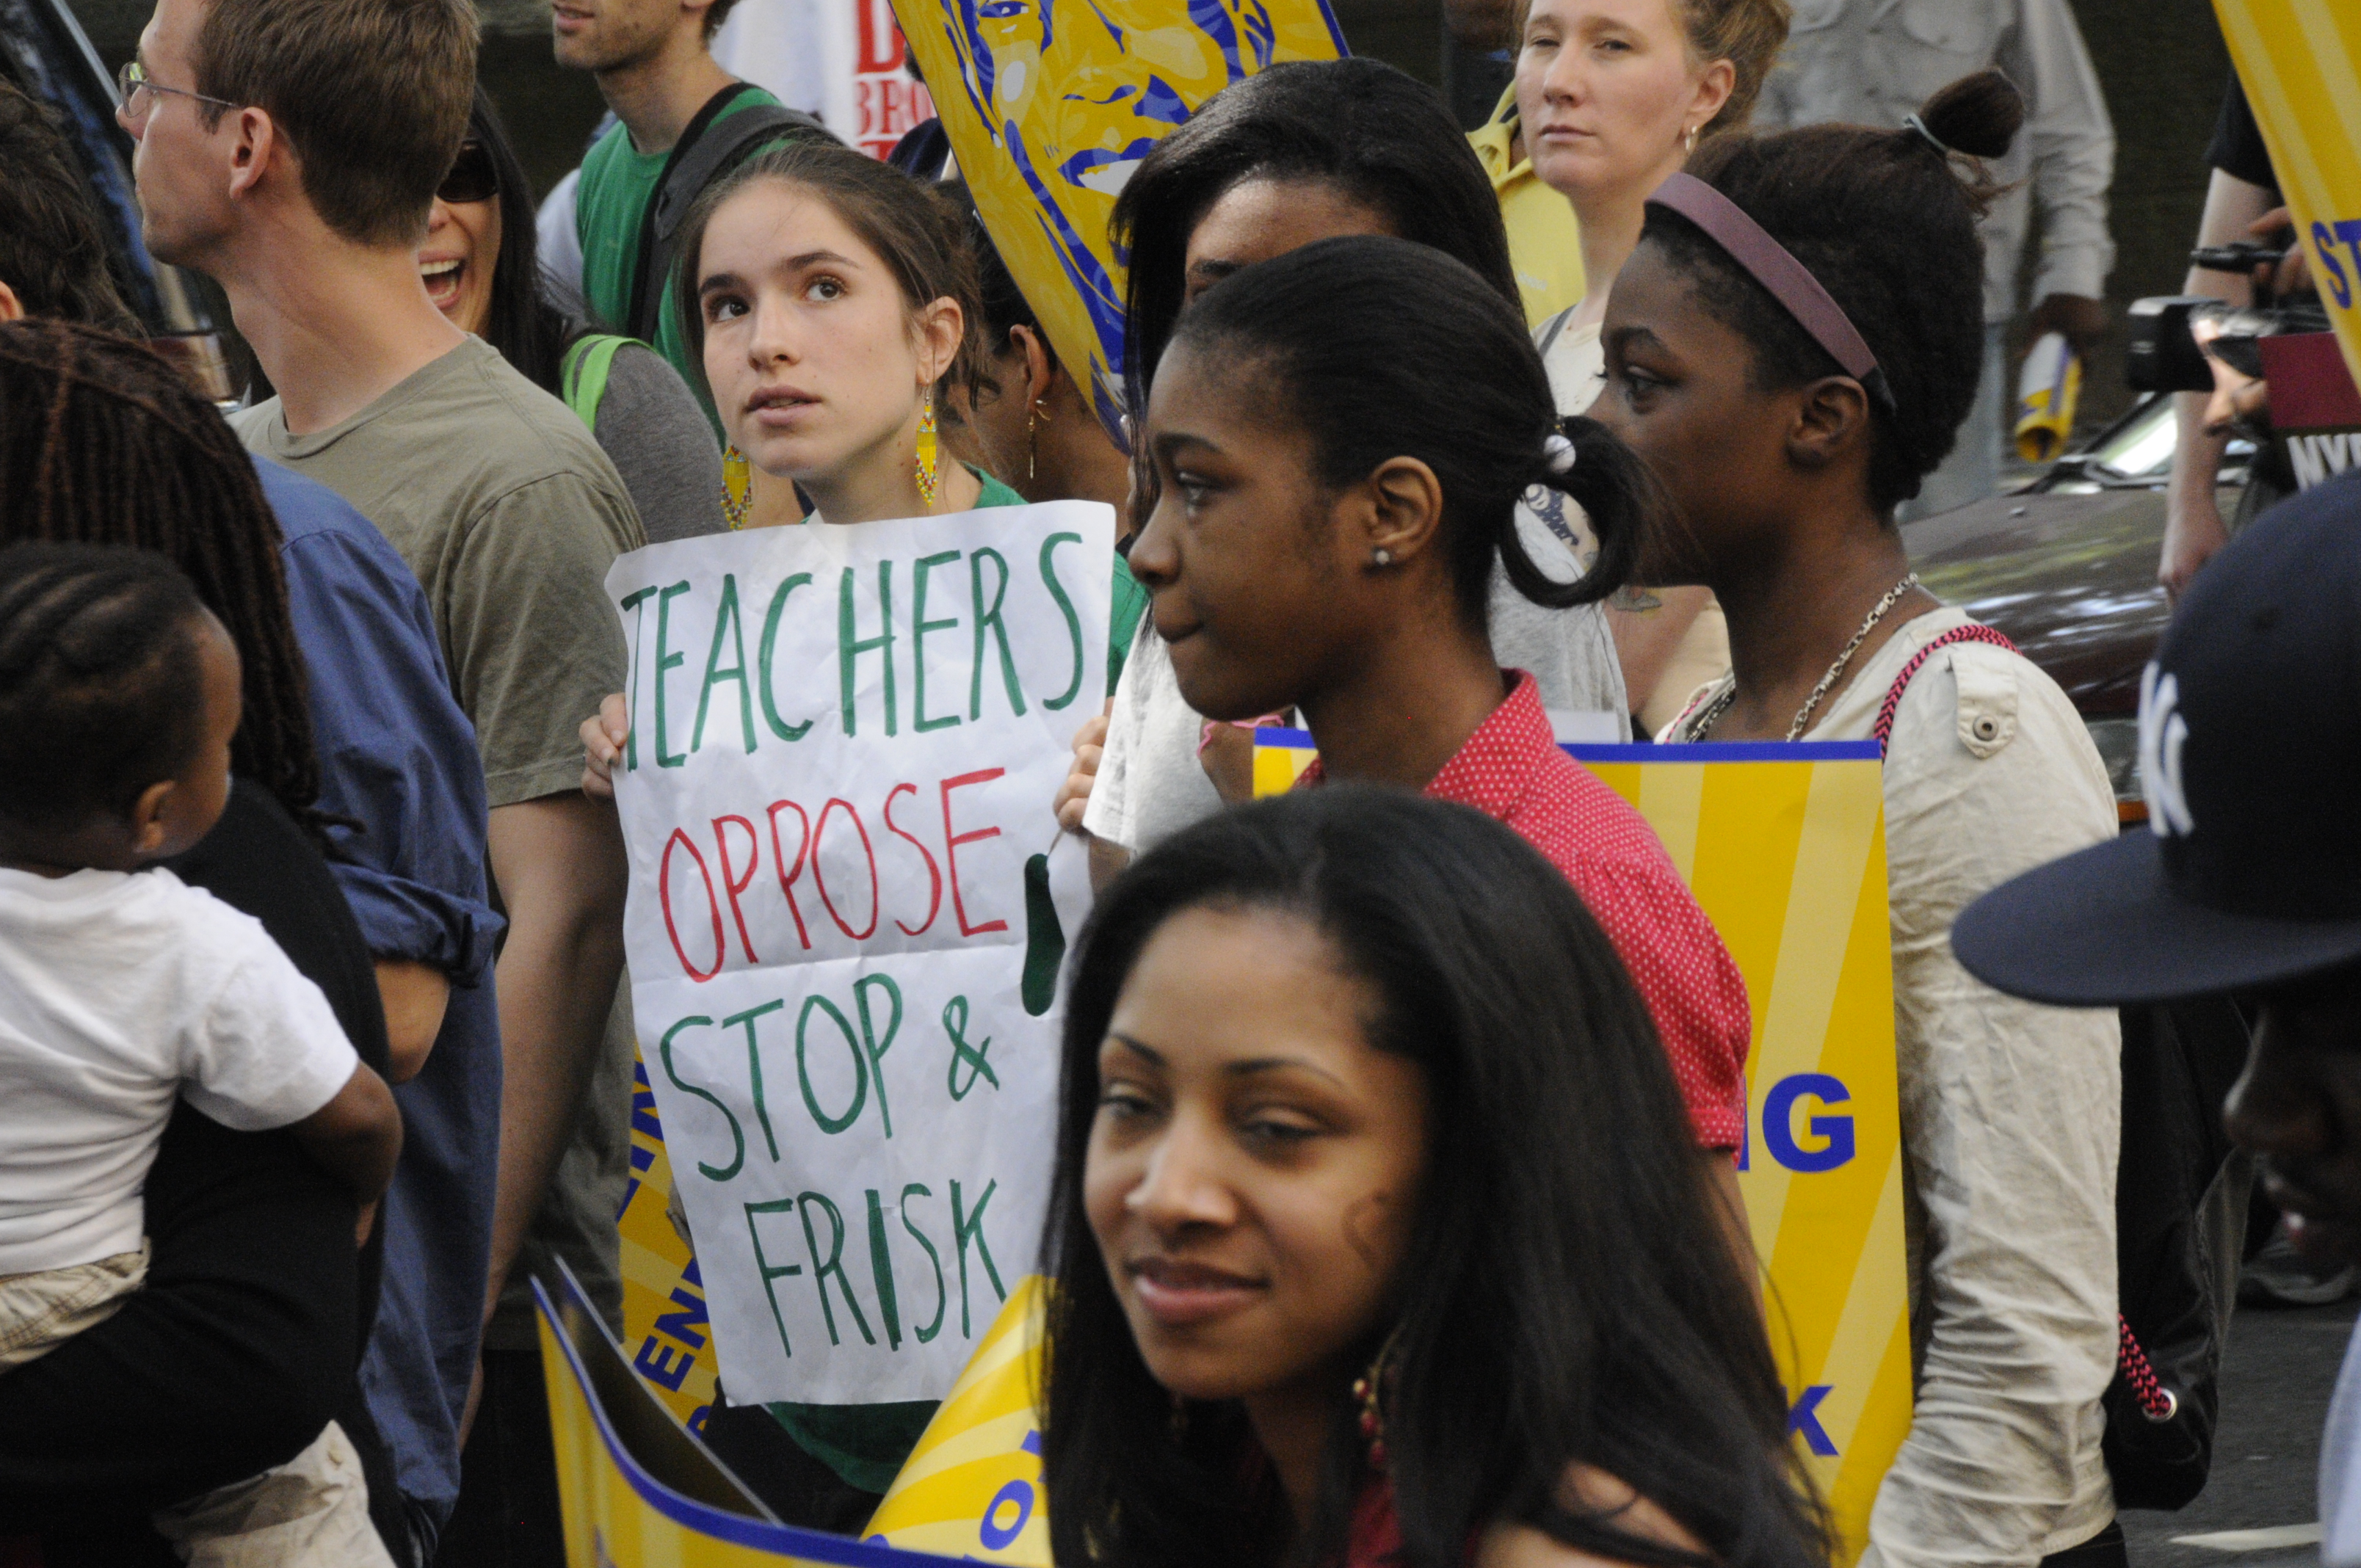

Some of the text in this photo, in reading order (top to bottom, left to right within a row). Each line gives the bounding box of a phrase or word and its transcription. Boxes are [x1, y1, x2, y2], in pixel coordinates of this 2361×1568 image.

[620, 531, 1083, 771] TEACHERS
[659, 766, 1009, 982] OPPOSE
[660, 973, 902, 1182] STOP
[941, 995, 999, 1101] &
[1737, 1072, 1856, 1174] G
[634, 1257, 712, 1393] EN
[744, 1178, 1007, 1358] FRISK
